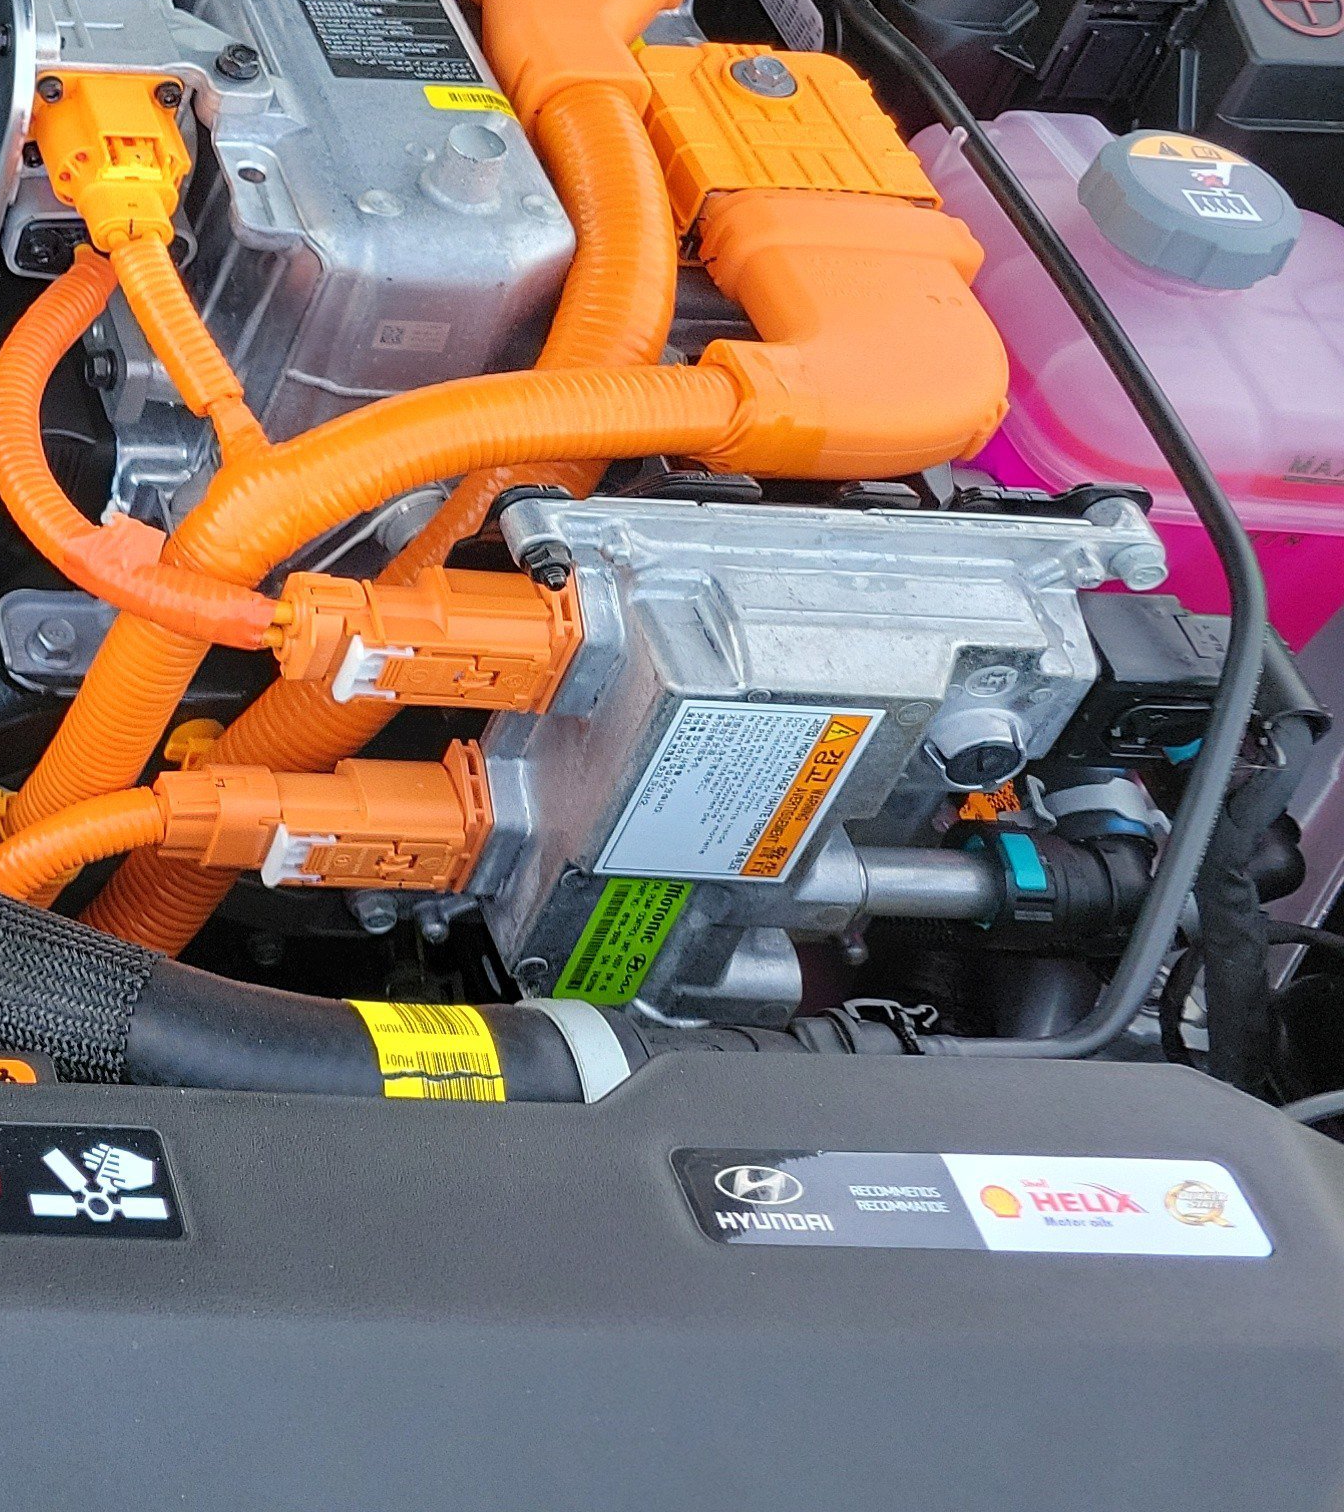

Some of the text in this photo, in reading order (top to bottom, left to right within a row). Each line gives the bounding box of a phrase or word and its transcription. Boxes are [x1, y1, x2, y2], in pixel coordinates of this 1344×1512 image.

[802, 749, 845, 783] 경고
[384, 1053, 414, 1068] HU01
[849, 1185, 942, 1198] RECOMMENDS
[857, 1200, 951, 1213] RECOMMANDE
[1027, 1190, 1146, 1213] HELIX
[714, 1211, 835, 1231] HYUNDAI
[1044, 1216, 1086, 1228] Motor
